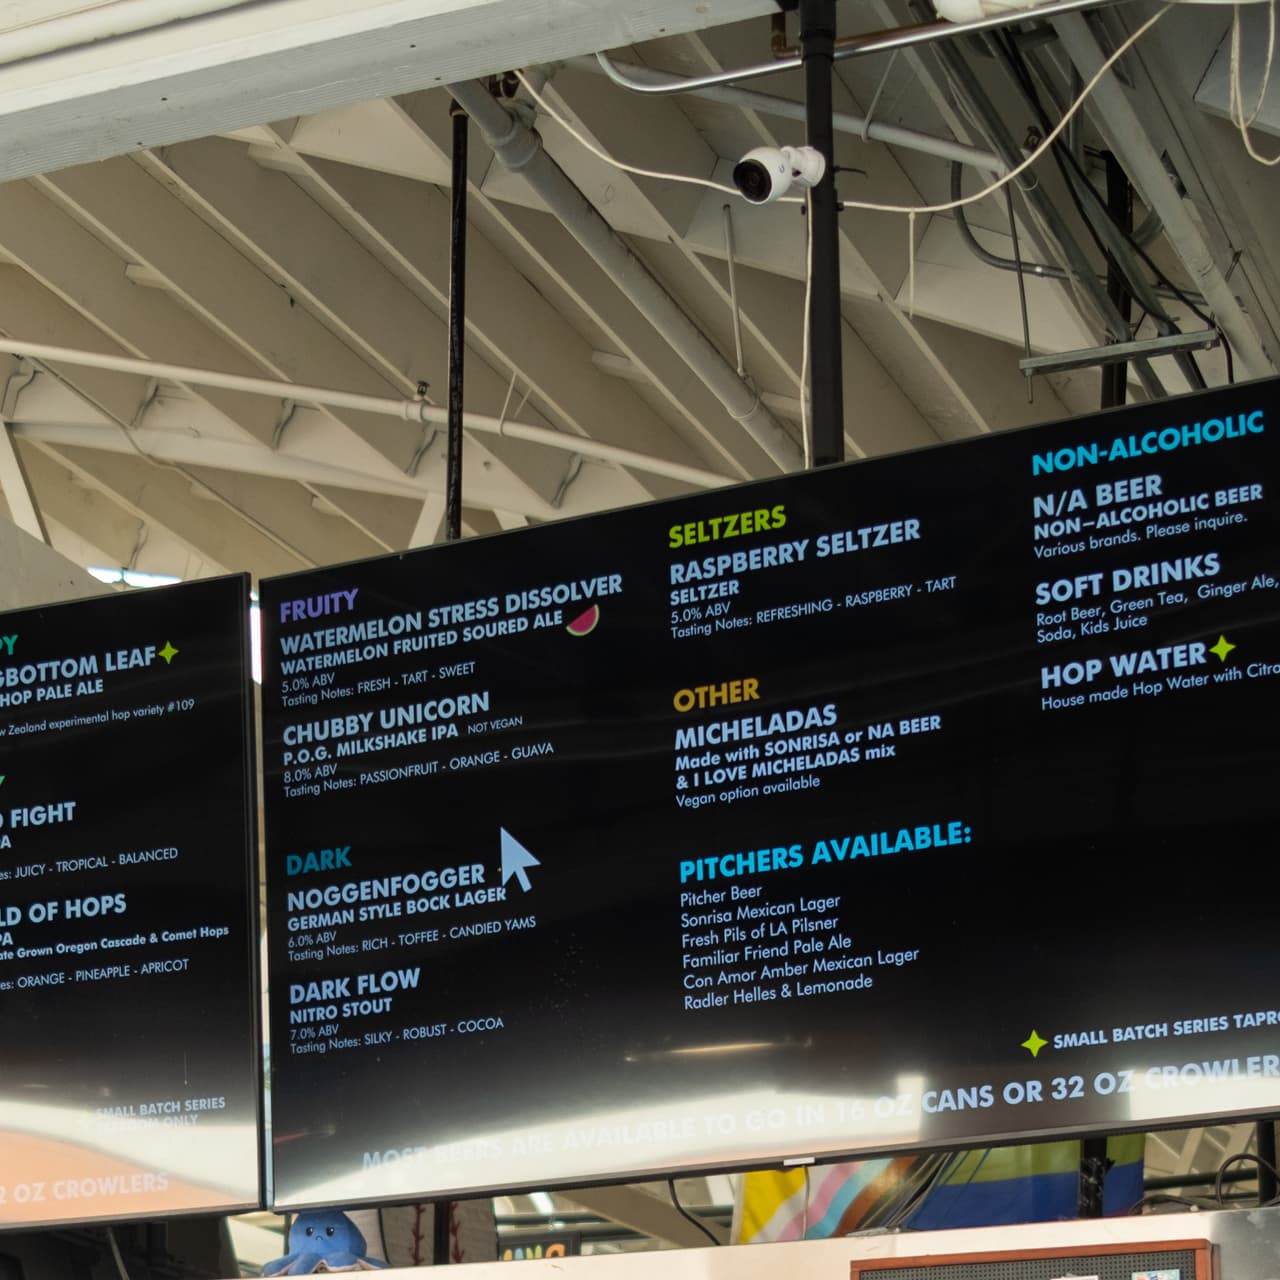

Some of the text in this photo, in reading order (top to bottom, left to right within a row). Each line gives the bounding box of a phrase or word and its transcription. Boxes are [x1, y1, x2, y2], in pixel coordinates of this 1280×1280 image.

[1031, 410, 1265, 476] NON-ALCOHOLIC
[1033, 474, 1163, 518] N/A BEER
[668, 505, 787, 548] SELTZERS
[670, 519, 921, 585] RASPBERRY SELTZER
[1035, 553, 1220, 606] SOFT DRINKS
[280, 588, 359, 623] FRUITY
[106, 646, 157, 671] LEAF
[1040, 642, 1207, 689] HOP WATER
[673, 678, 760, 712] OTHER
[1041, 693, 1085, 711] House
[1088, 686, 1128, 704] made
[1132, 680, 1163, 697] Hop
[1166, 673, 1208, 690] Water
[1213, 666, 1242, 683] with
[8, 720, 47, 736] Zealand
[49, 710, 109, 733] experimental
[111, 707, 131, 723] hop
[133, 704, 165, 720] variety
[168, 699, 195, 712] #109
[283, 691, 490, 747] CHUBBY UNICORN
[674, 704, 838, 750] MICHELADAS
[11, 801, 76, 829] FIGHT
[286, 846, 353, 875] DARK
[679, 821, 972, 883] PITCHERS AVAILABLE:
[287, 864, 486, 912] NOGGENFOGGER
